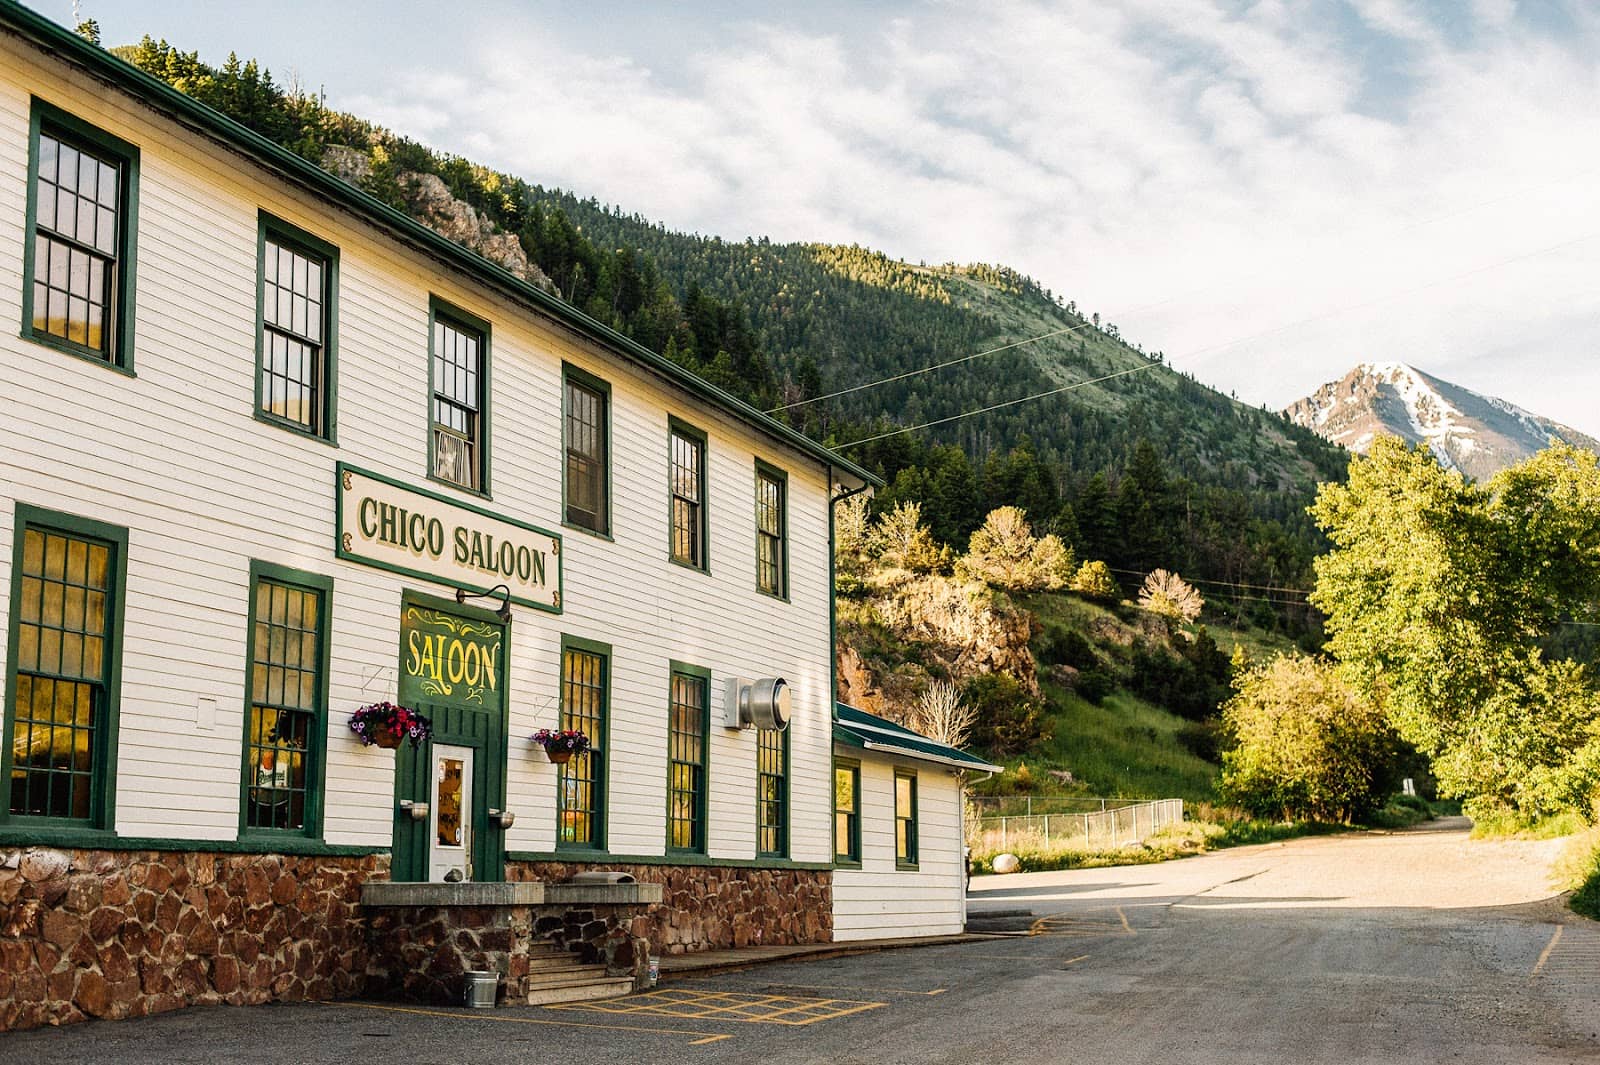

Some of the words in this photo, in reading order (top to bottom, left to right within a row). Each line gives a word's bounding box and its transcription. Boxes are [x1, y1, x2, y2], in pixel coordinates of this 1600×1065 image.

[360, 496, 444, 556] CHICO
[454, 526, 546, 587] SALOON
[406, 629, 501, 695] SALOON
